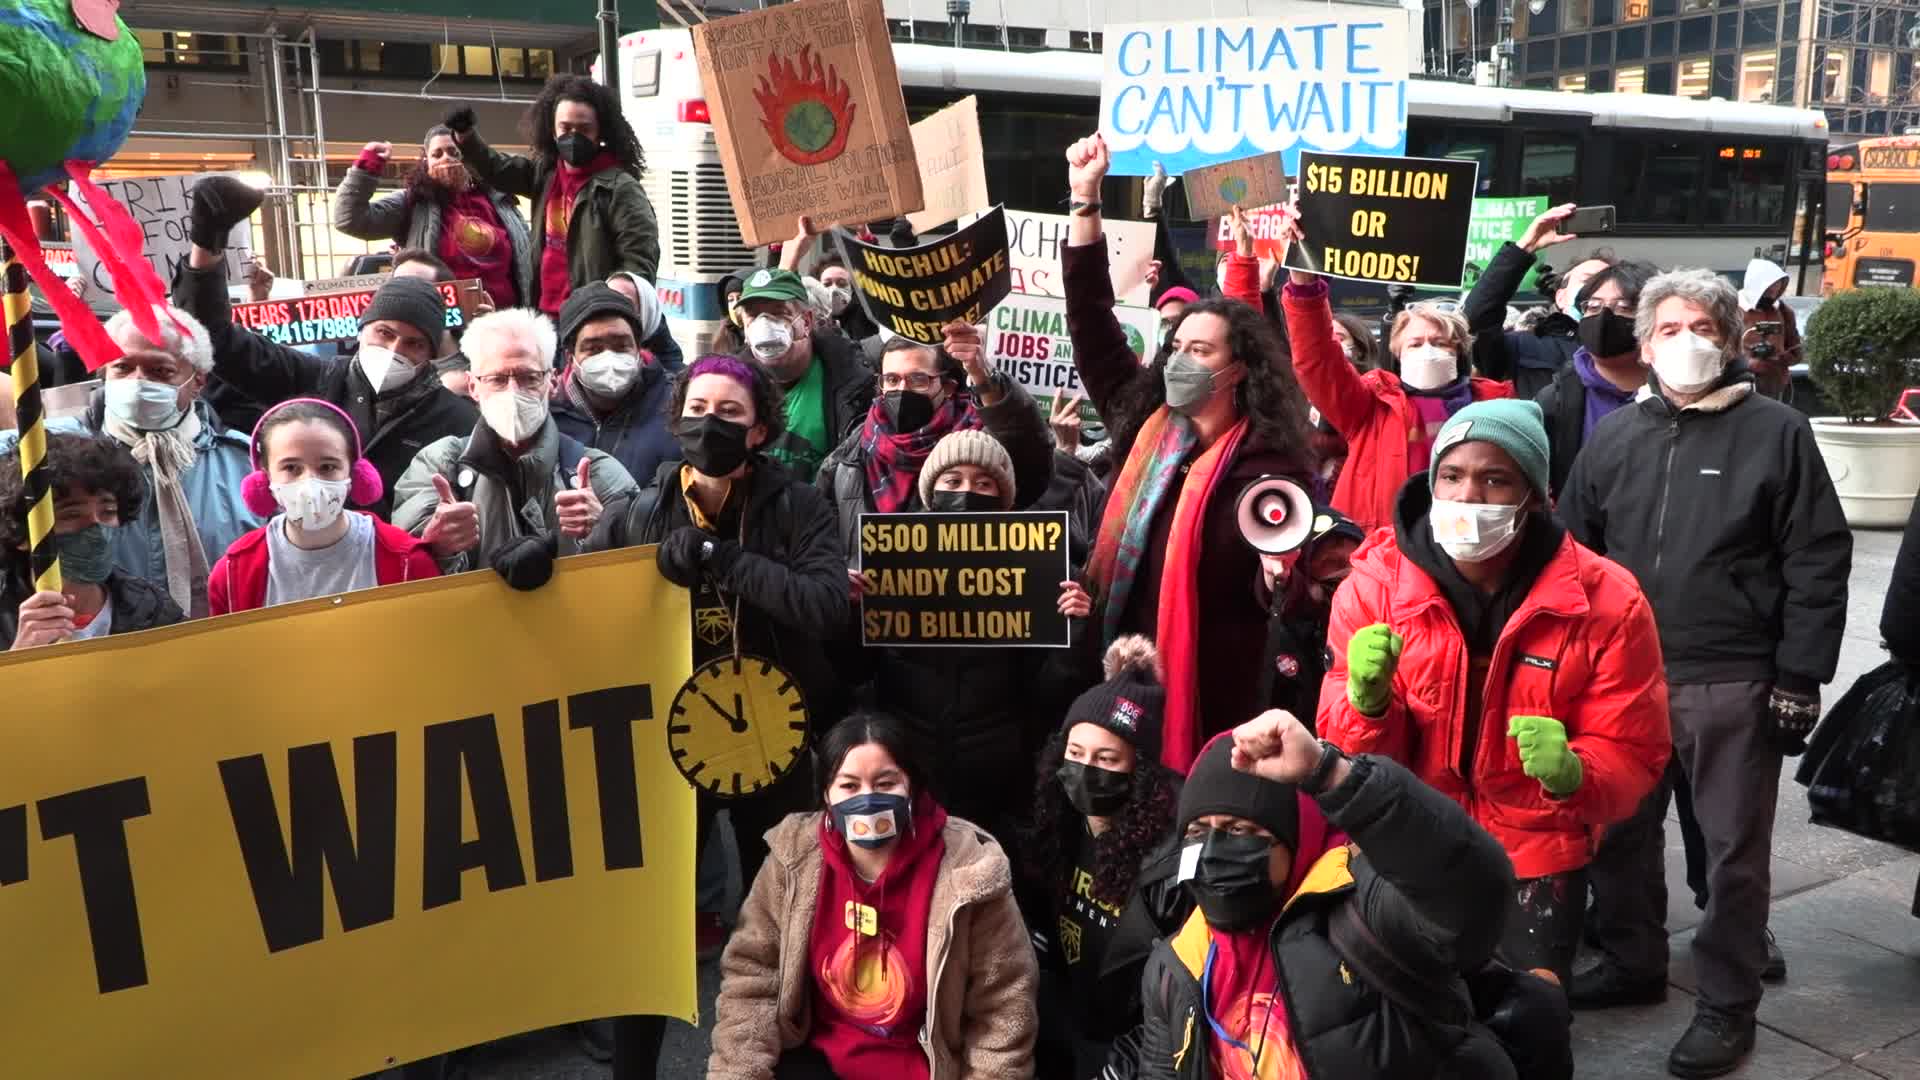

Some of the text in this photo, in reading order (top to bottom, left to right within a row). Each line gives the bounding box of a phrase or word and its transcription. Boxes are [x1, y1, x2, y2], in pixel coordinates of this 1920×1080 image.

[1118, 23, 1384, 77] CLIMATE
[1112, 76, 1405, 135] CAN'T WAIT!
[1306, 162, 1448, 200] $15 BILLION
[1351, 209, 1386, 238] OR
[862, 241, 971, 279] HOCHUL:
[1324, 247, 1420, 281] FLOODS!
[1466, 242, 1492, 261] OW
[317, 276, 385, 291] CLIMATE CLOC
[910, 250, 1005, 311] CLIMATE
[996, 306, 1070, 336] CLIMA
[995, 333, 1073, 360] JOBS AN
[862, 522, 1061, 554] $500 MILLION?
[864, 568, 1026, 596] SANDY COST
[865, 608, 1031, 640] $70 BILLION!
[217, 683, 654, 954] WAIT
